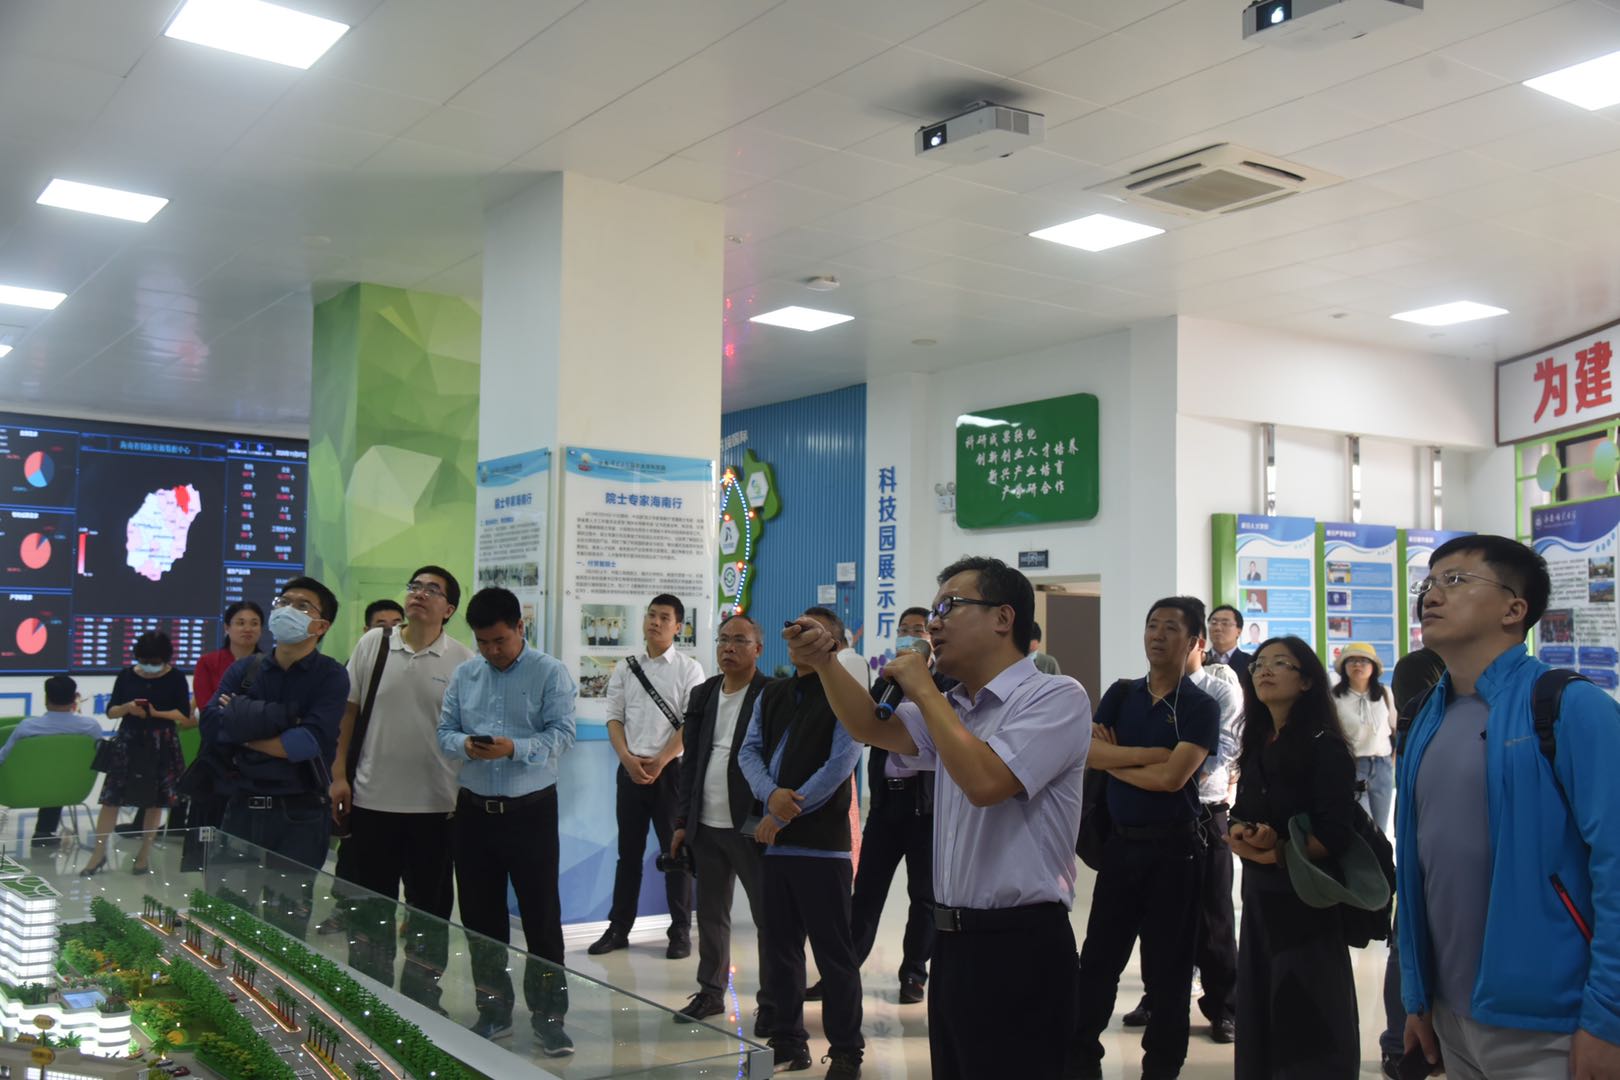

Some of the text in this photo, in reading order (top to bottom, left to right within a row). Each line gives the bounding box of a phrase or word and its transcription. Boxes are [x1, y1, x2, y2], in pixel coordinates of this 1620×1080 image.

[1534, 341, 1613, 423] 为建
[965, 428, 1037, 450] 科研成果转化
[976, 437, 1079, 466] 创新创业人才培养
[987, 460, 1064, 485] 新兴产业培育
[495, 492, 532, 509] 院士专家海南行
[605, 492, 683, 509] 院士专家海南行
[1001, 480, 1065, 501] 产学研合作
[877, 466, 897, 639] 科技园展示厅
